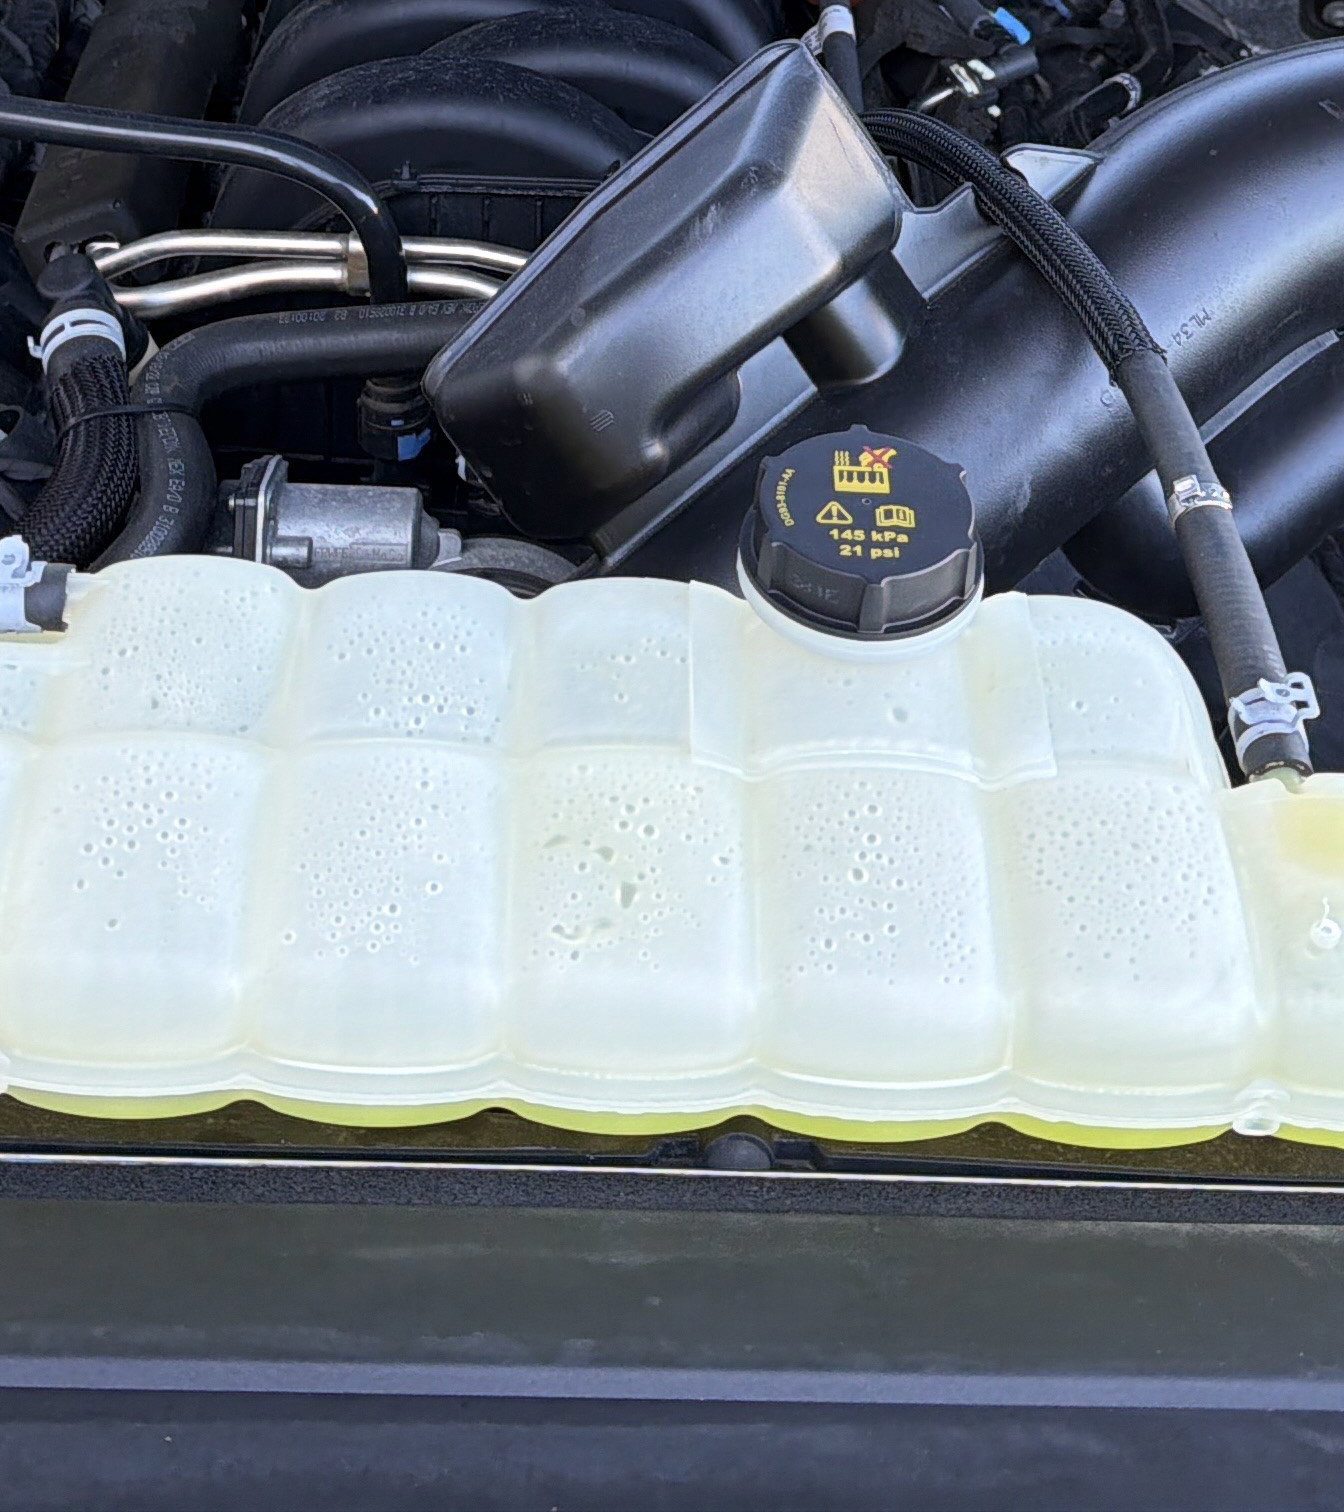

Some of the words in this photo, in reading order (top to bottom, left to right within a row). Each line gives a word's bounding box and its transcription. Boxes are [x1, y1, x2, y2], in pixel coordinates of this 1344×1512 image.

[829, 528, 865, 541] 145
[871, 530, 909, 543] kPa
[839, 544, 863, 557] 21
[870, 546, 900, 559] psi
